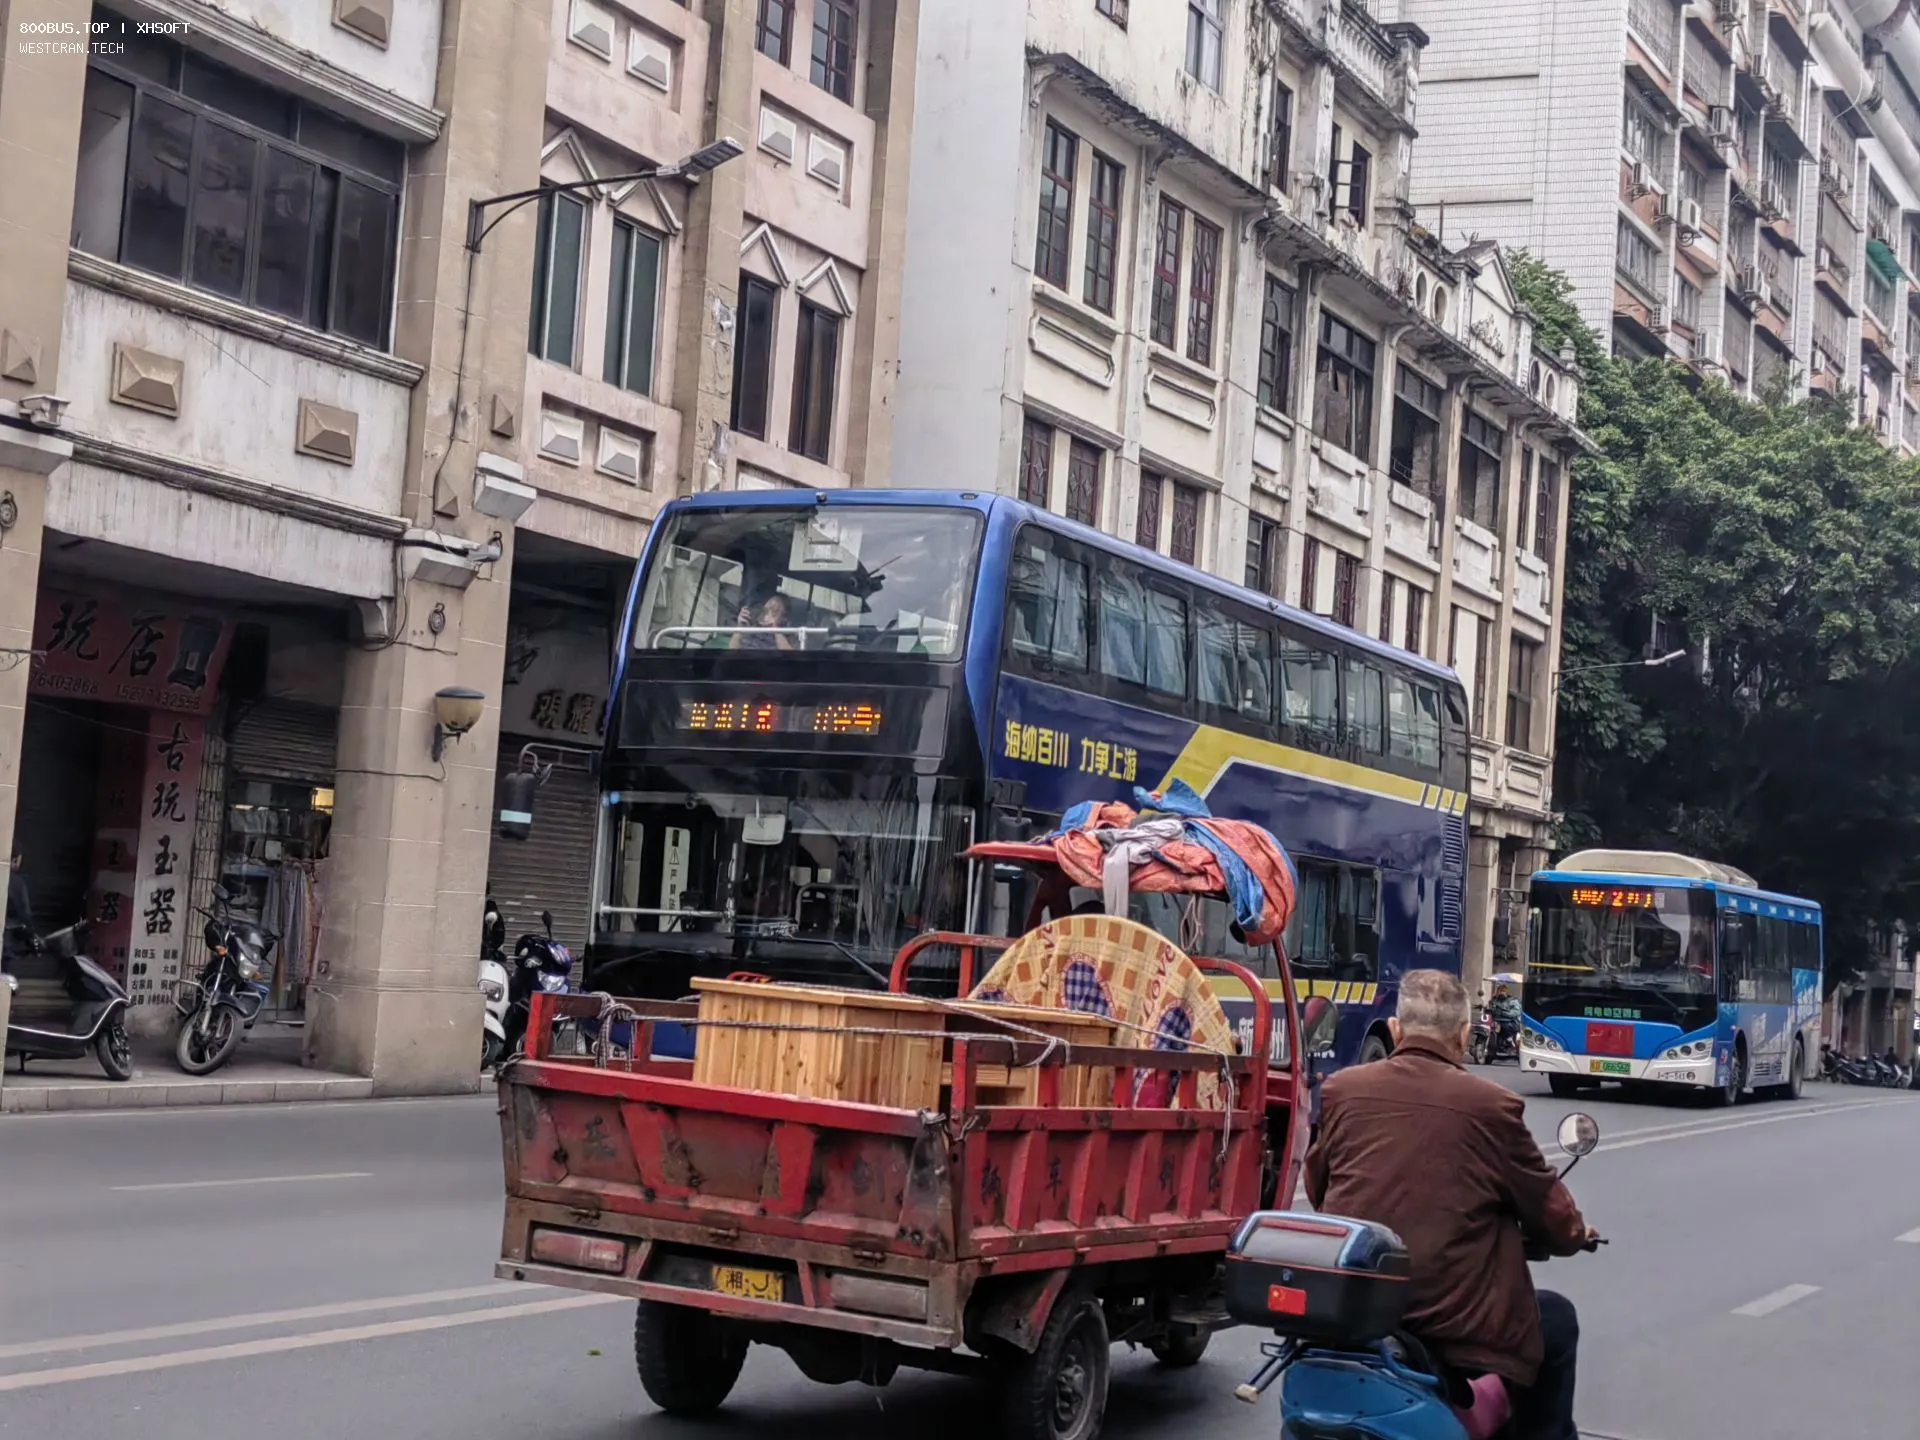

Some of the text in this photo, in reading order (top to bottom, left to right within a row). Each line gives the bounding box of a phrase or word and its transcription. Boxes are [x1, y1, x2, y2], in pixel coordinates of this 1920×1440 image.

[1004, 719, 1139, 782] 海纳百川 力争上游
[143, 721, 191, 938] 古玩玉器
